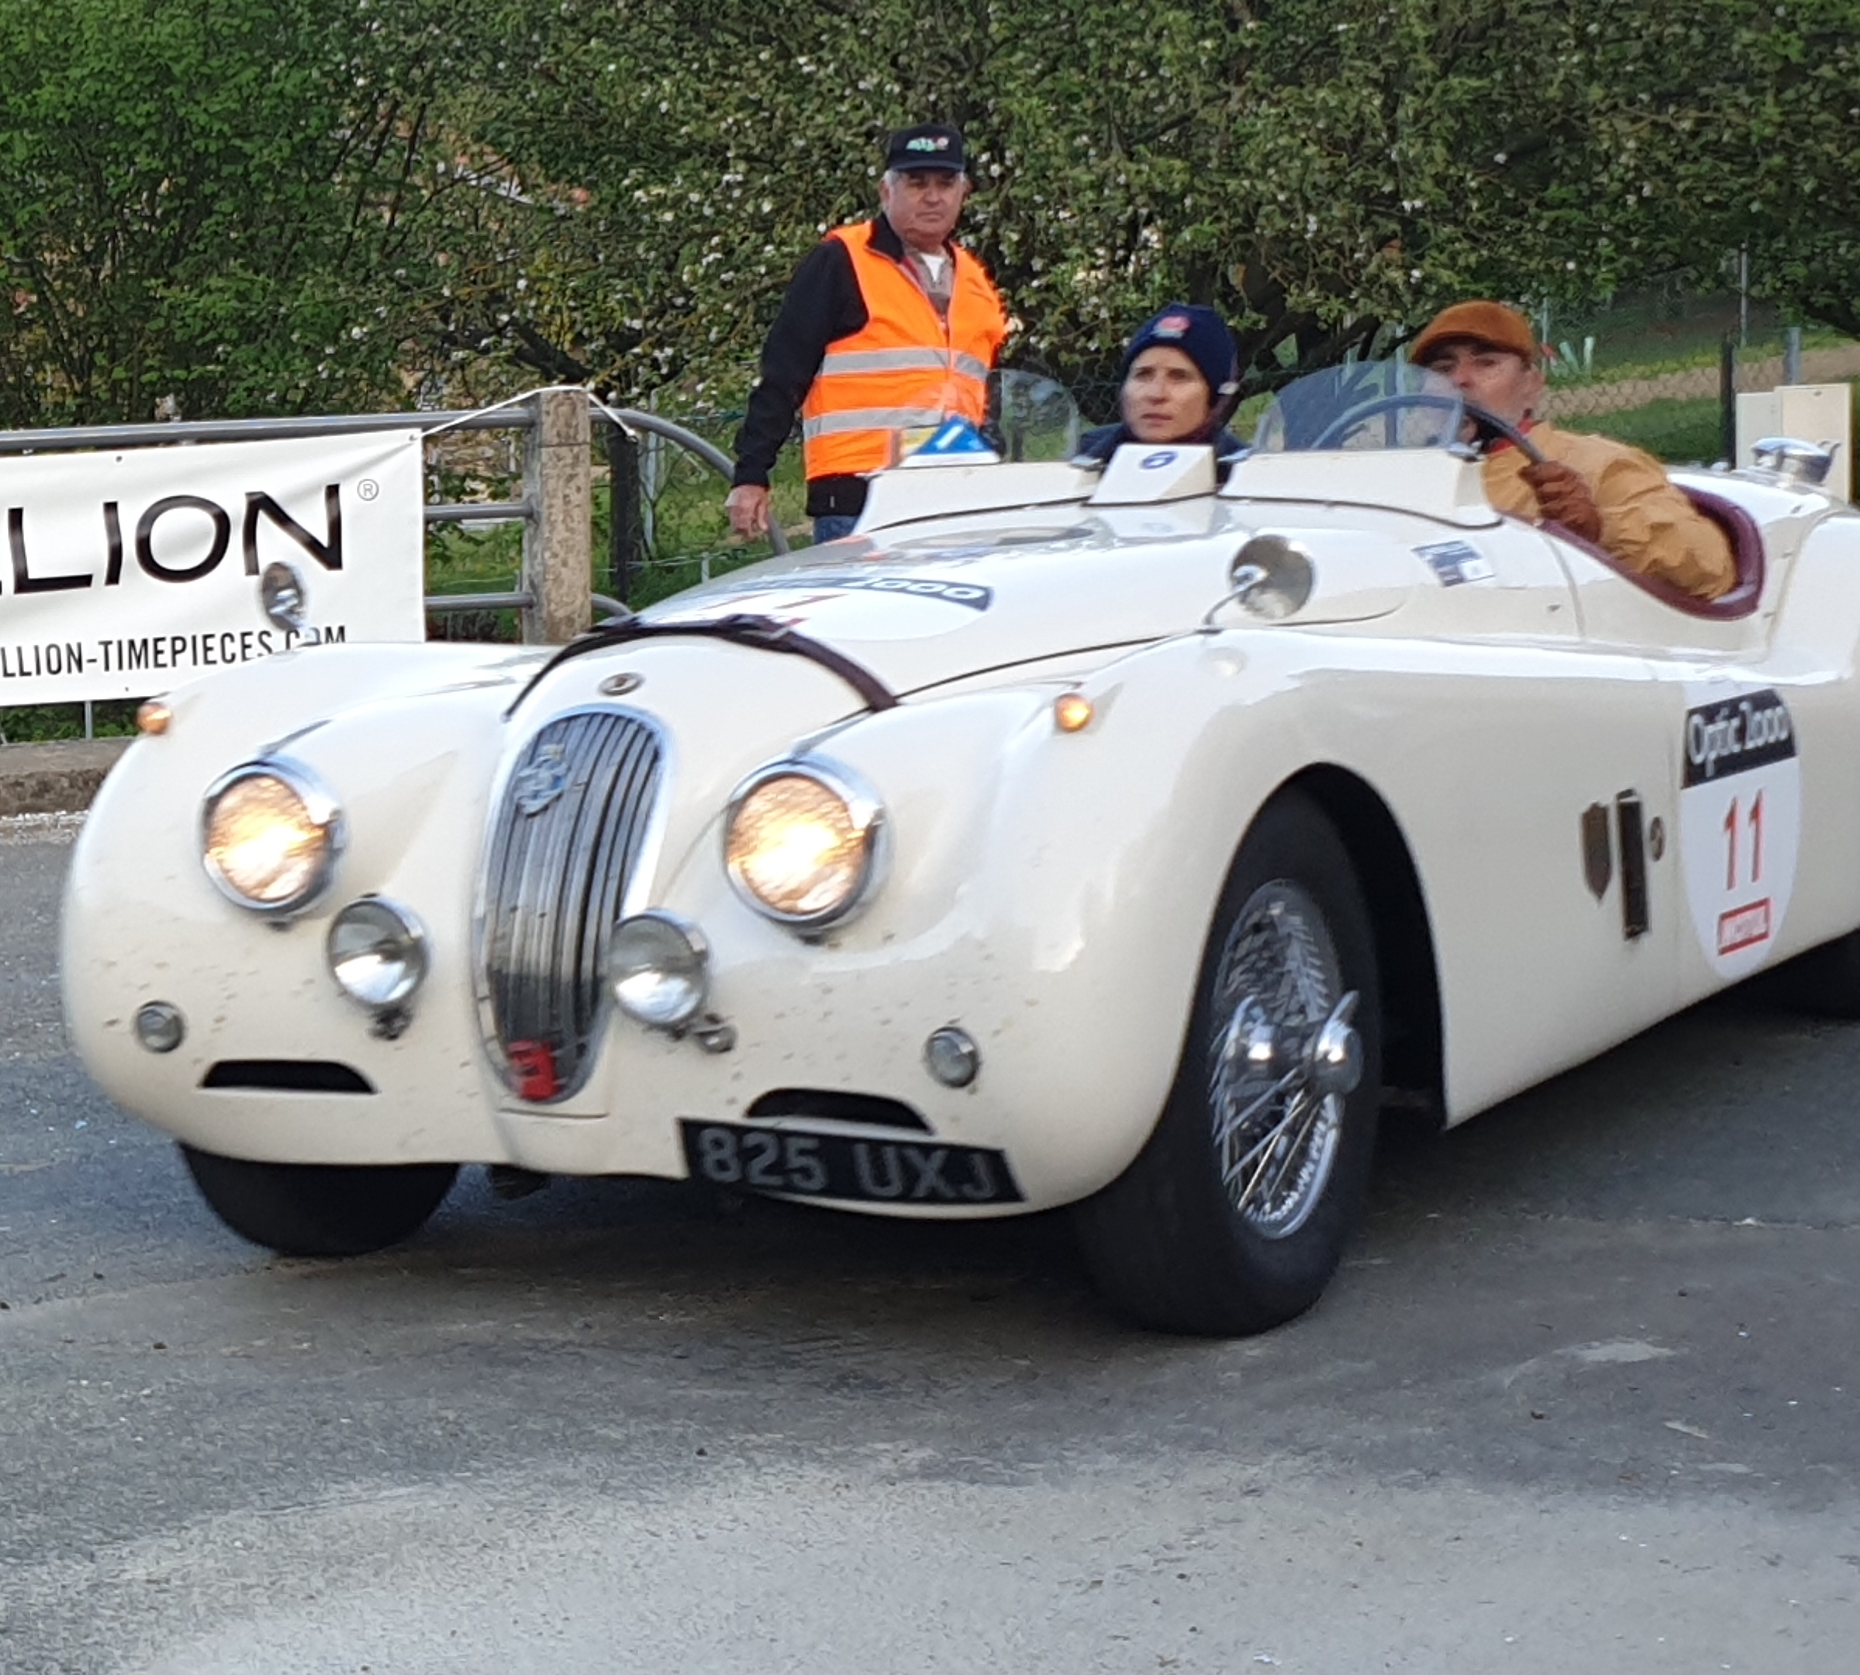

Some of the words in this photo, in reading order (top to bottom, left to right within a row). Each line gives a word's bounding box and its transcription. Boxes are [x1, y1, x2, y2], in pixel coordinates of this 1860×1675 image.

[0, 483, 343, 595] LION
[0, 625, 346, 678] LLION-TIMEPIECESCM
[1688, 706, 1742, 778] Optic
[1739, 701, 1790, 750] 2000
[1723, 788, 1766, 891] 11
[699, 1126, 828, 1192] 825
[852, 1142, 998, 1199] UXJ
